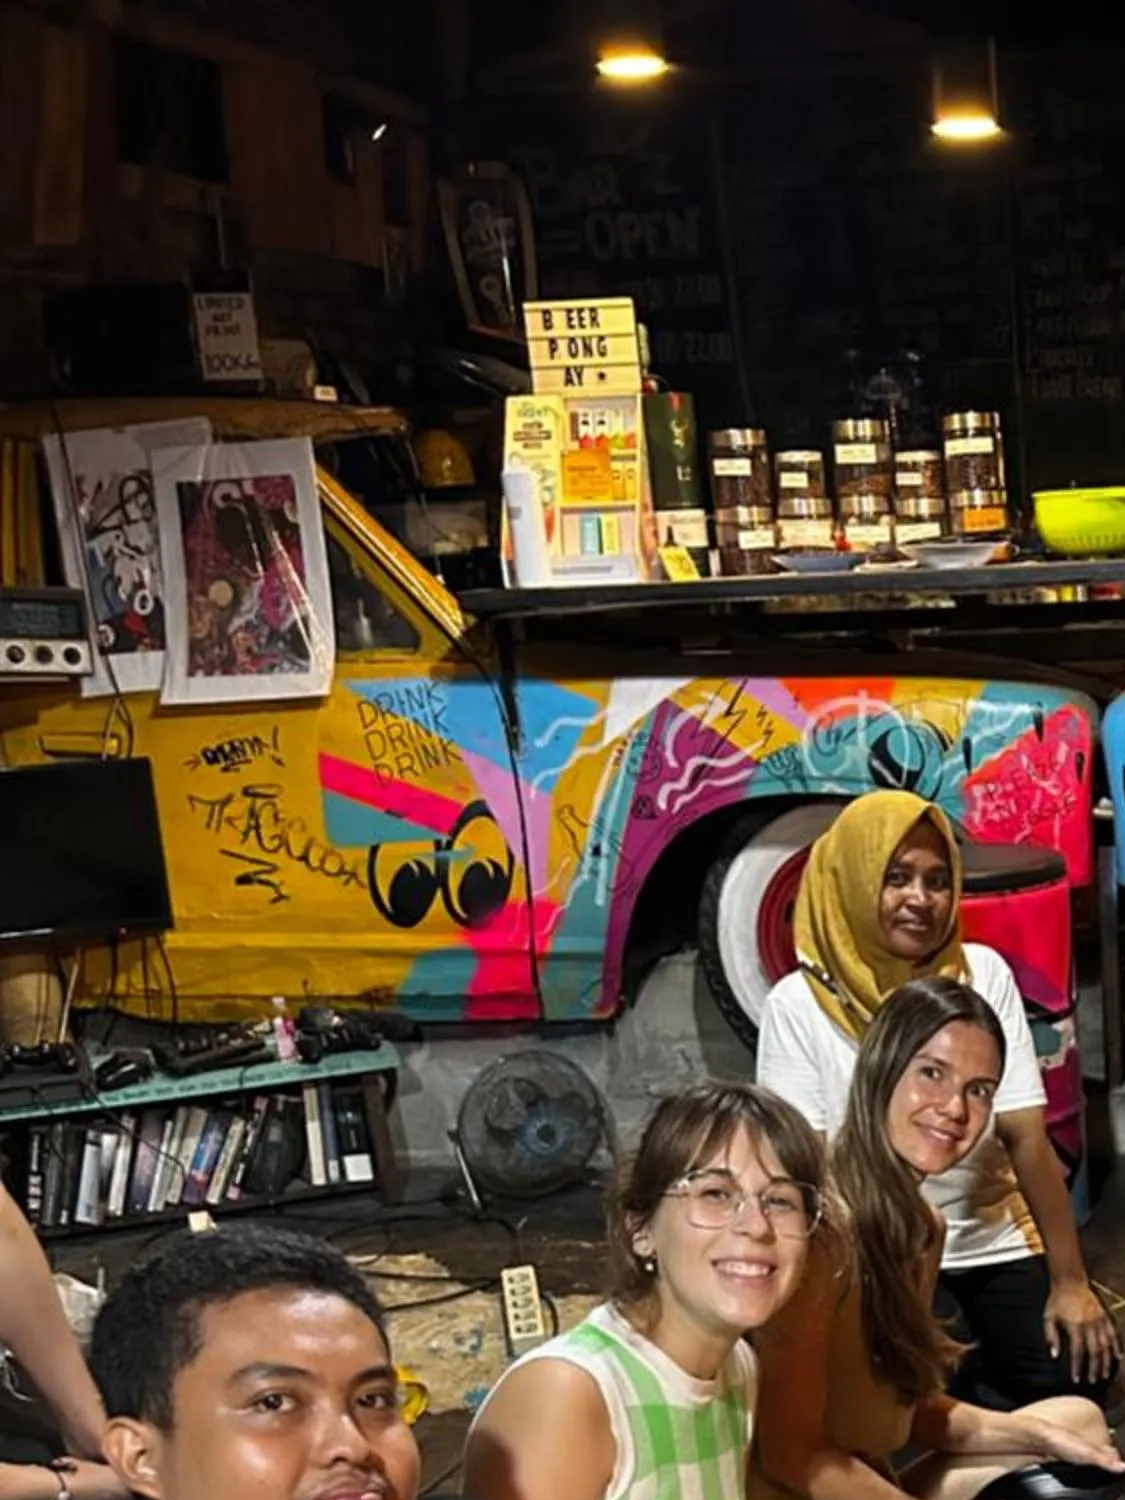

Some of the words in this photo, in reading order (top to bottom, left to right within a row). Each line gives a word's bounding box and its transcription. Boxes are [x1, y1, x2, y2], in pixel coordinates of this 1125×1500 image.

[564, 366, 584, 387] AY
[357, 681, 445, 729] DRINK
[365, 705, 449, 761] DRINK
[374, 738, 464, 790] DRINK
